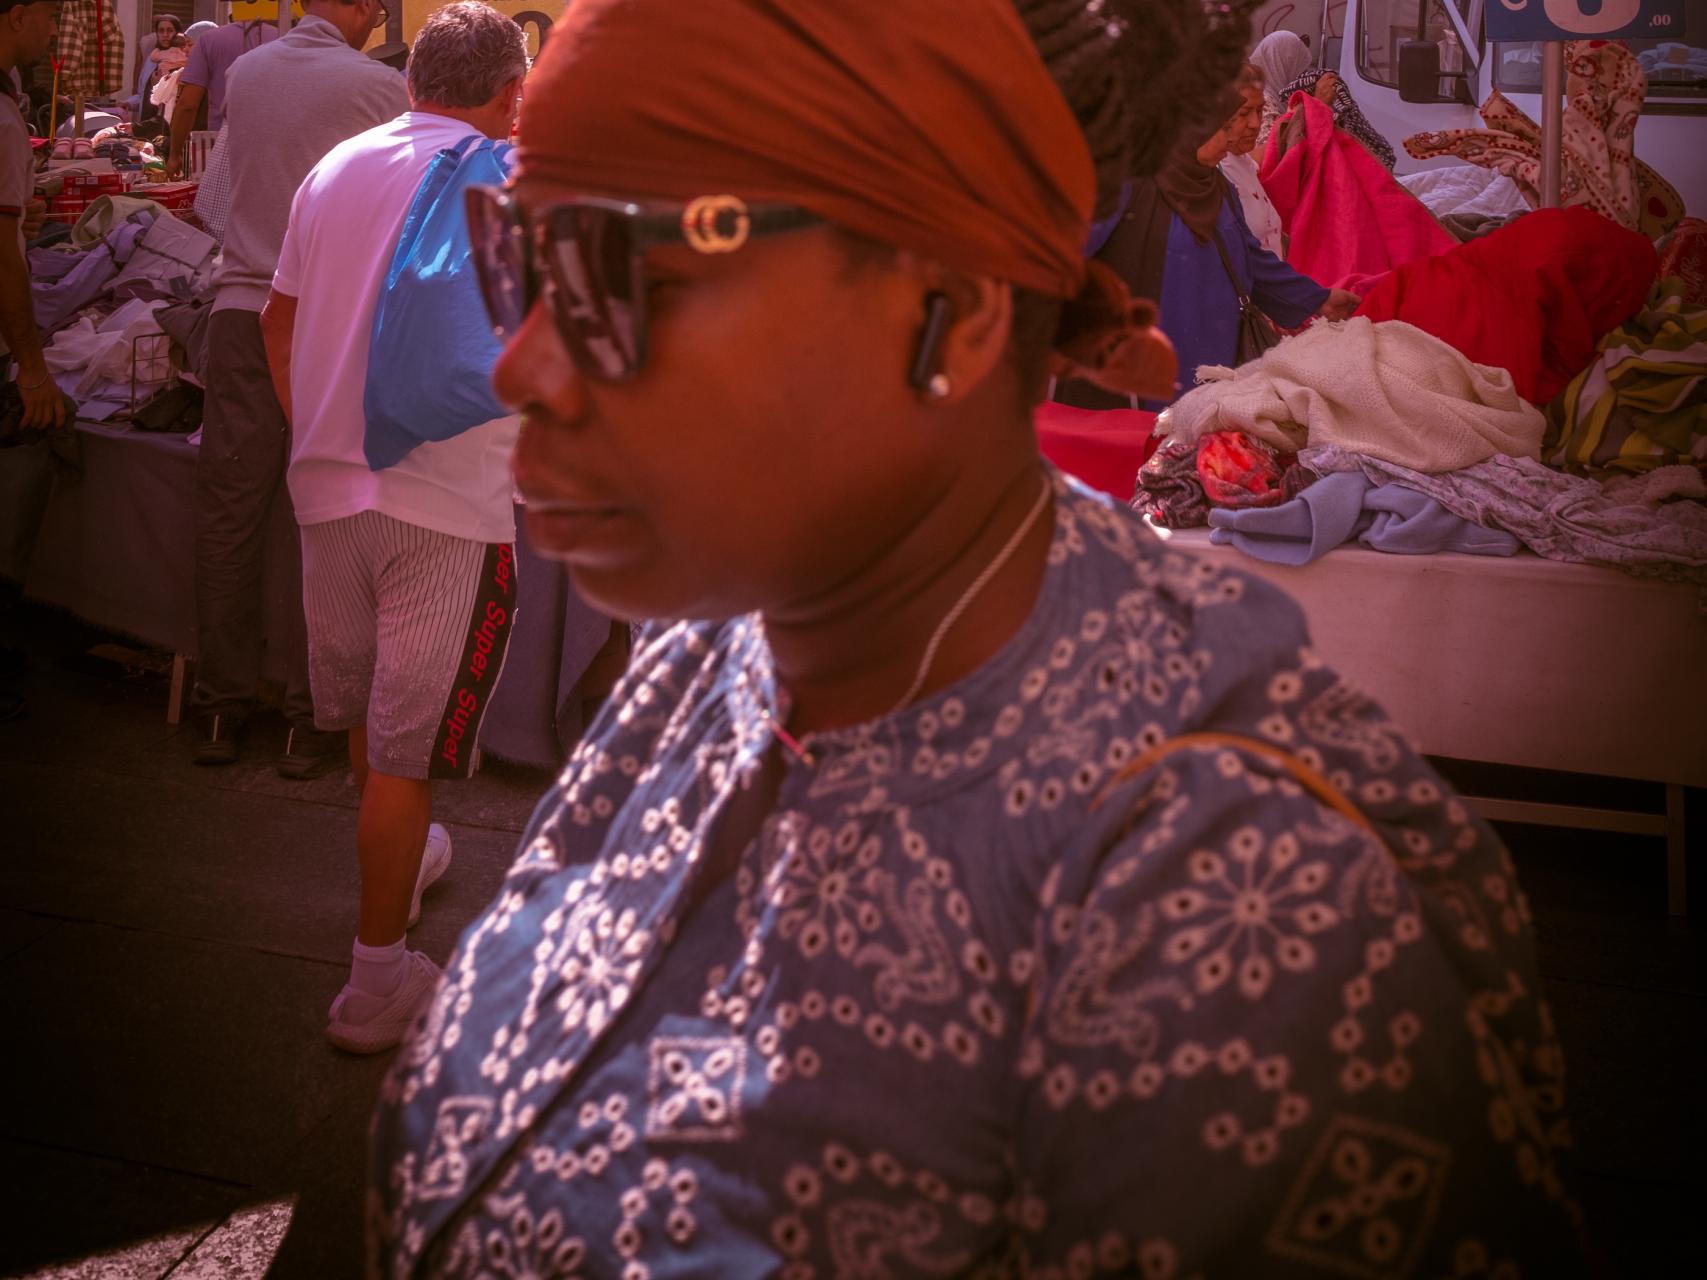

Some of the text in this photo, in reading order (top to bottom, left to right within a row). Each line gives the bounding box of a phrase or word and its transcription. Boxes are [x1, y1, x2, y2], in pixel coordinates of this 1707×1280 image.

[441, 543, 513, 768] per Super Super
